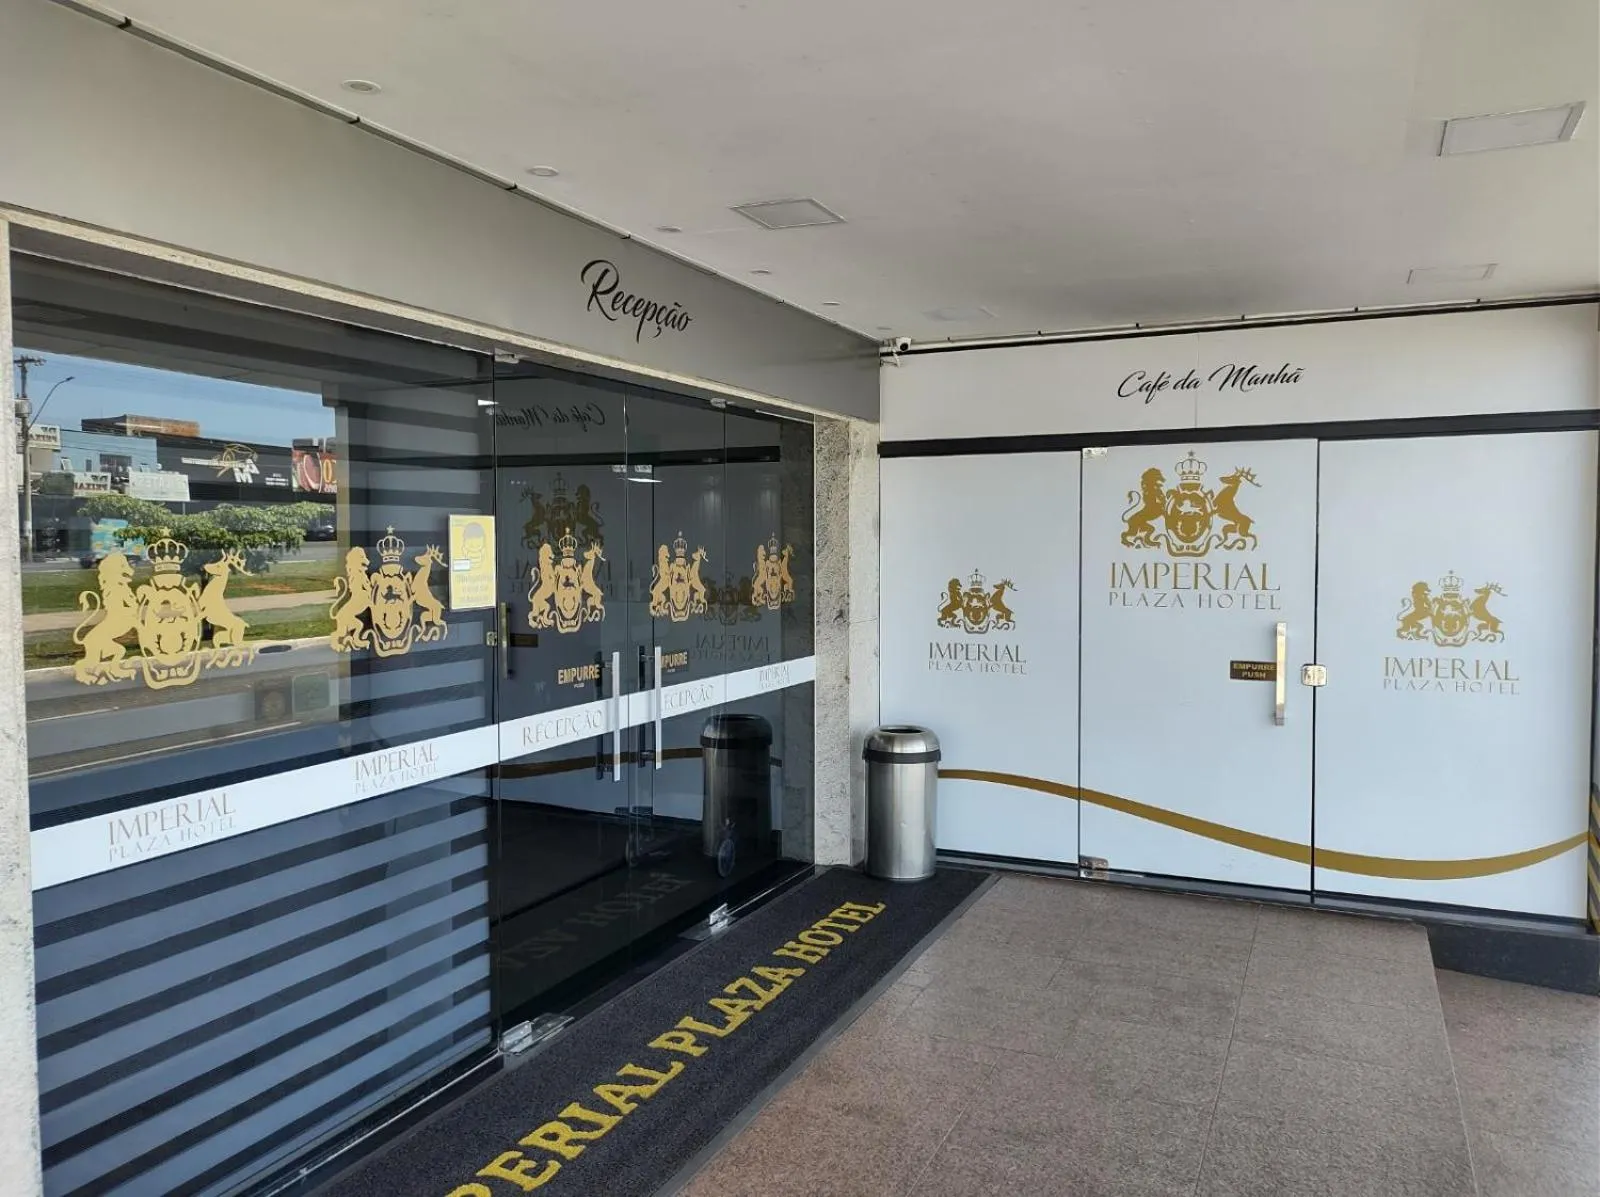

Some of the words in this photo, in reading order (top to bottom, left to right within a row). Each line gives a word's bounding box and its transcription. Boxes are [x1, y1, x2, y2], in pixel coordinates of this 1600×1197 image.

[580, 259, 694, 344] Recepção
[1117, 370, 1172, 405] Café
[1172, 369, 1200, 391] da
[1207, 362, 1306, 393] Manhã
[1109, 562, 1282, 591] IMPERIAL
[1108, 592, 1186, 609] PLAZA
[1198, 593, 1282, 611] HOTEL
[929, 641, 1027, 663] IMPERIAL
[558, 664, 601, 685] EMPURRE
[928, 660, 973, 672] PLAZA
[980, 662, 1028, 676] HOTEL
[1383, 656, 1521, 682] IMPERIAL
[662, 683, 714, 711] ECEPÇÃO
[1382, 678, 1445, 693] PLAZA
[1455, 680, 1521, 696] HOTEL
[354, 742, 440, 781] IMPERIAL
[107, 793, 237, 846] IMPERIAL
[108, 834, 172, 863] PLAZA
[180, 816, 237, 844] HOTEL
[647, 964, 806, 1057] PLAZA
[772, 900, 887, 965] HOTEL
